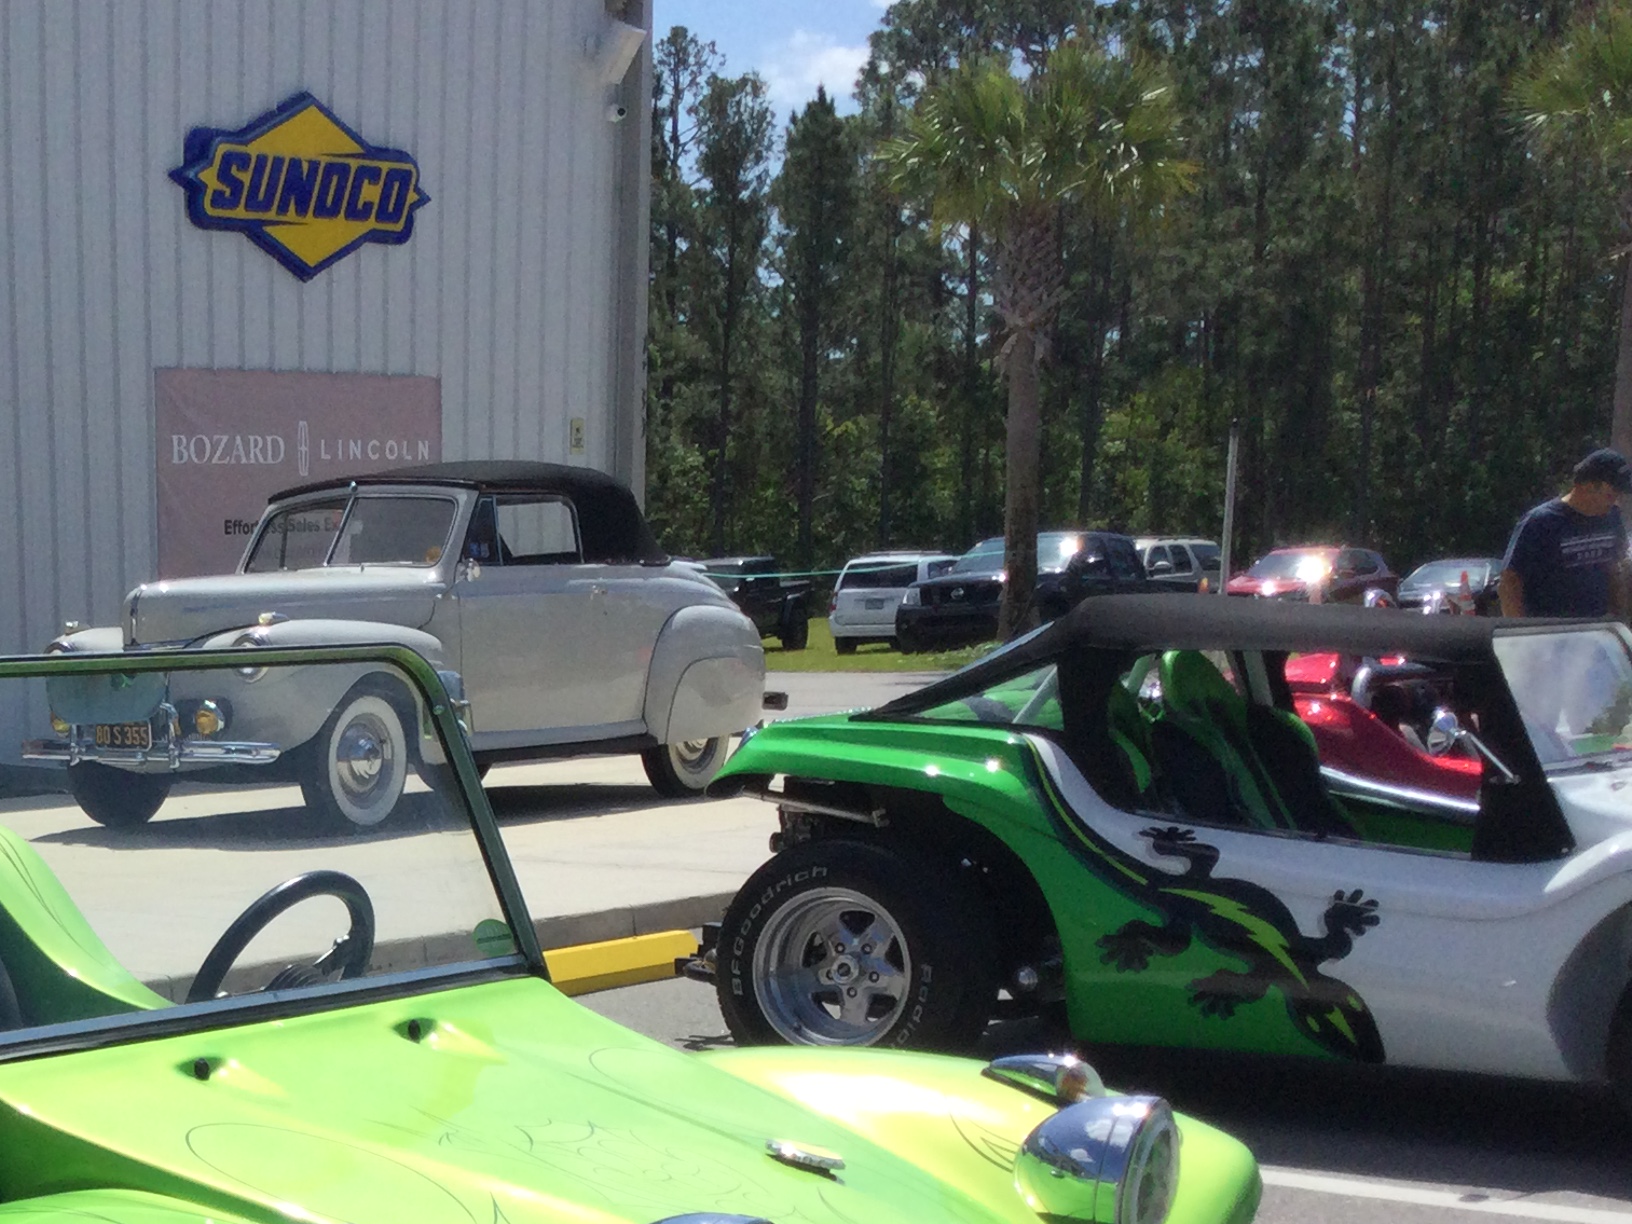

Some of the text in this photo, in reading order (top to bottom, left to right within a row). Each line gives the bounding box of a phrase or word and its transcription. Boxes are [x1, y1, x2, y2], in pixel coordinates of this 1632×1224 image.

[209, 149, 413, 224] SUNOCO
[171, 434, 431, 465] BOZARD LINCOLN
[730, 865, 829, 997] BFGoodrich
